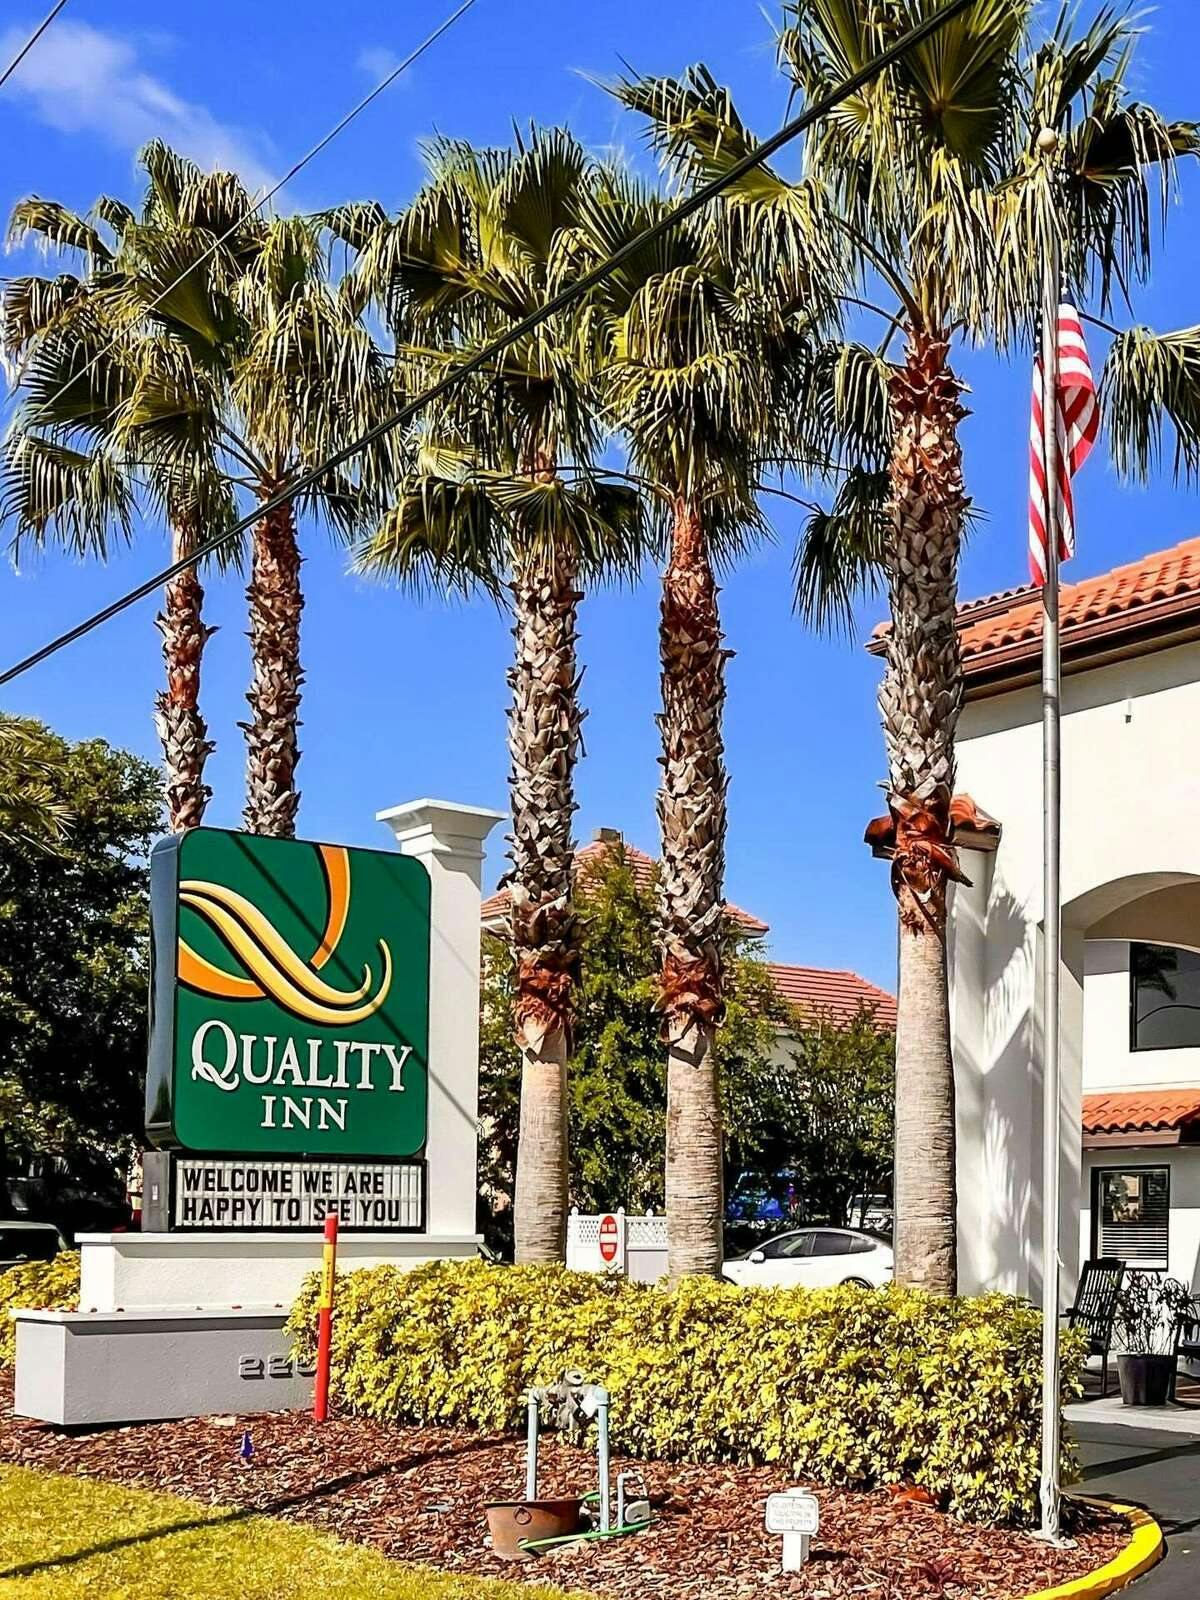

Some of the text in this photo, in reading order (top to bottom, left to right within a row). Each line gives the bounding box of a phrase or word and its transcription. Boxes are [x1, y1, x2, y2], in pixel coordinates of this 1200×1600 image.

[191, 1019, 413, 1092] QUALITY
[260, 1094, 349, 1131] INN
[183, 1168, 385, 1195] WELCOME WE ARE
[183, 1197, 260, 1221] HAPPY
[273, 1198, 301, 1221] TO
[360, 1199, 400, 1222] YOU
